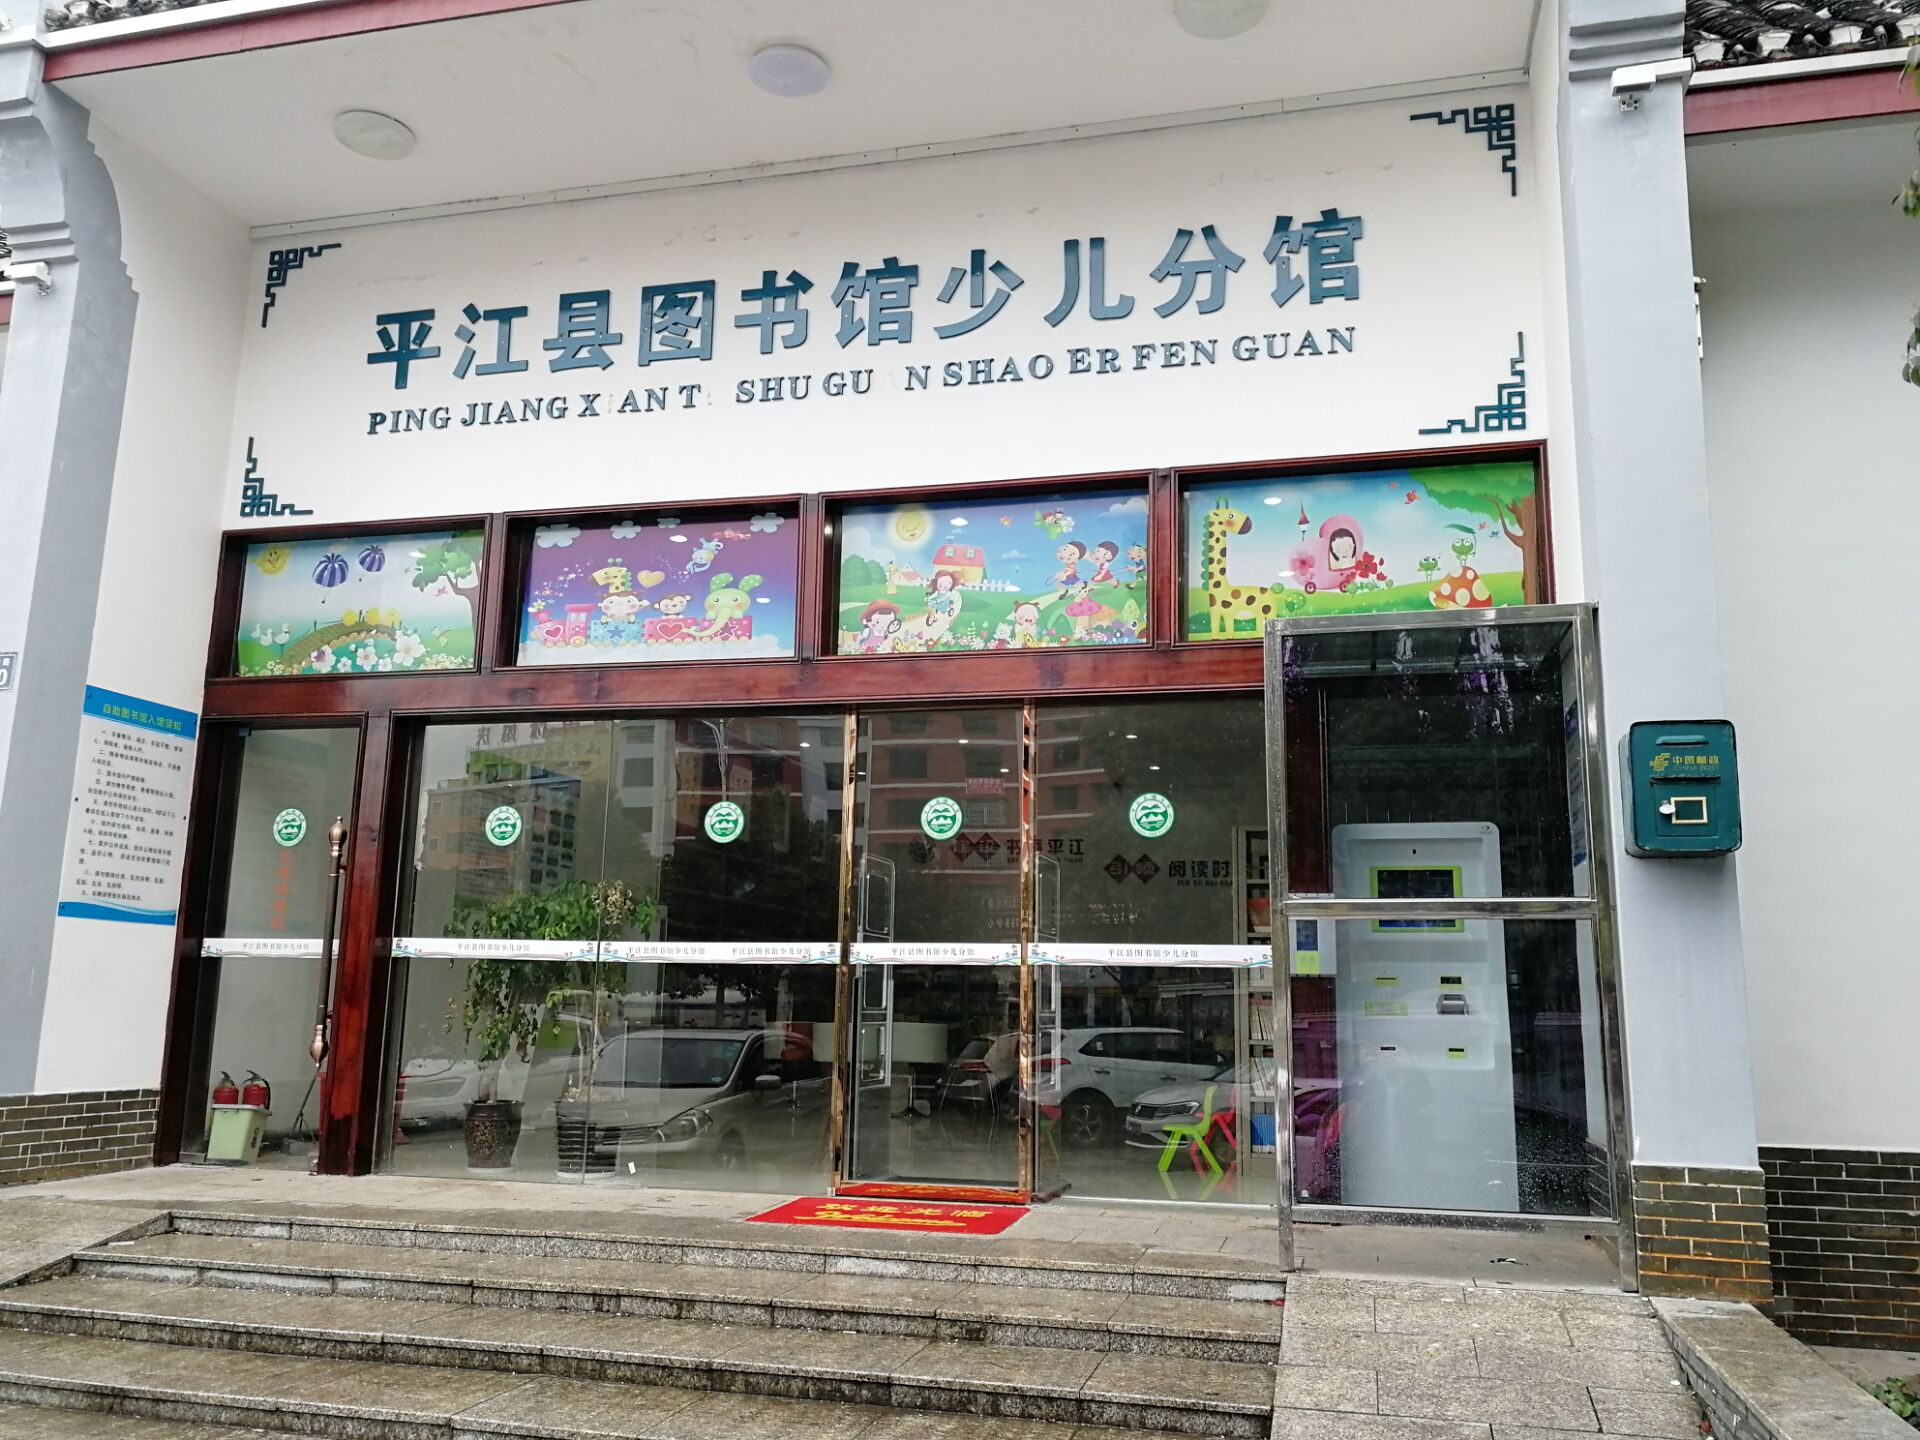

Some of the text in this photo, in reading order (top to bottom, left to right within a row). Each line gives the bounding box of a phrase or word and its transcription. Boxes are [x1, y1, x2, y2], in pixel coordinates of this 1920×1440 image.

[366, 206, 1364, 391] 平江县图书馆少儿分馆
[366, 405, 453, 436] PING
[460, 394, 569, 428] JIANG
[735, 374, 813, 405] SHU
[942, 352, 1056, 388] SHAO
[1065, 345, 1123, 377] ER
[1131, 338, 1220, 371] FEN
[1231, 325, 1358, 364] GUAN
[1672, 755, 1719, 765] 中国邮政
[891, 947, 975, 957] 平江县图书馆少儿分馆
[1108, 948, 1199, 959] 平江县图书馆少儿分馆
[815, 1203, 993, 1218] 欢迎光临
